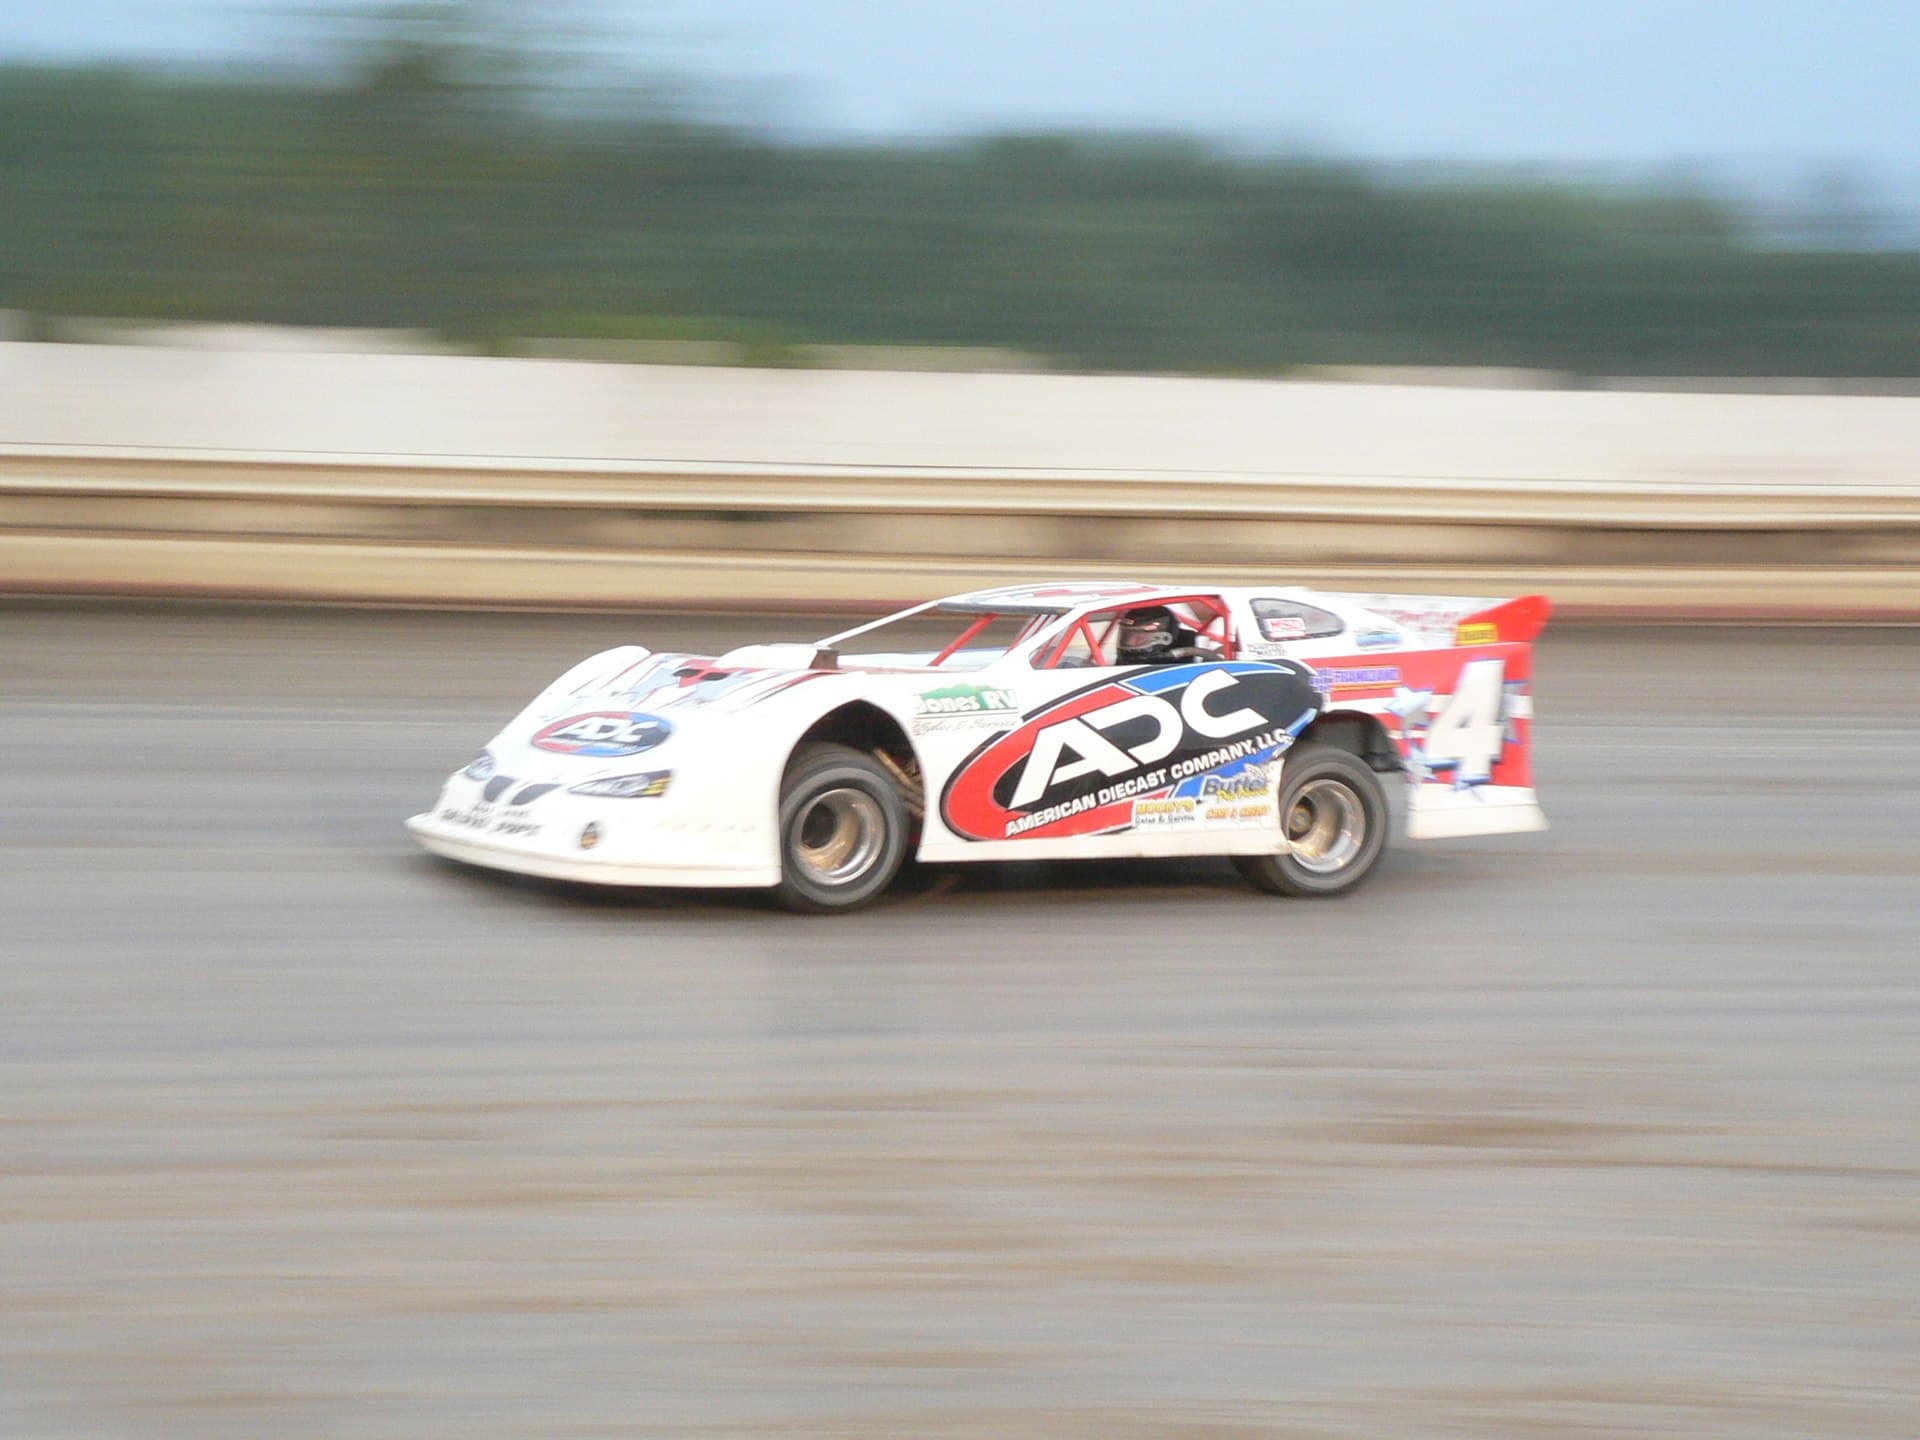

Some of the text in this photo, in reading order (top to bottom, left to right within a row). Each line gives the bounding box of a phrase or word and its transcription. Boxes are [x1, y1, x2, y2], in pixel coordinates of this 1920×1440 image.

[552, 716, 659, 744] ADC
[1009, 668, 1269, 810] ADC
[1423, 658, 1506, 777] 4
[1005, 793, 1097, 838] AMERICAN
[1098, 769, 1168, 807] DIECAST
[1170, 739, 1257, 779] COMPANY,
